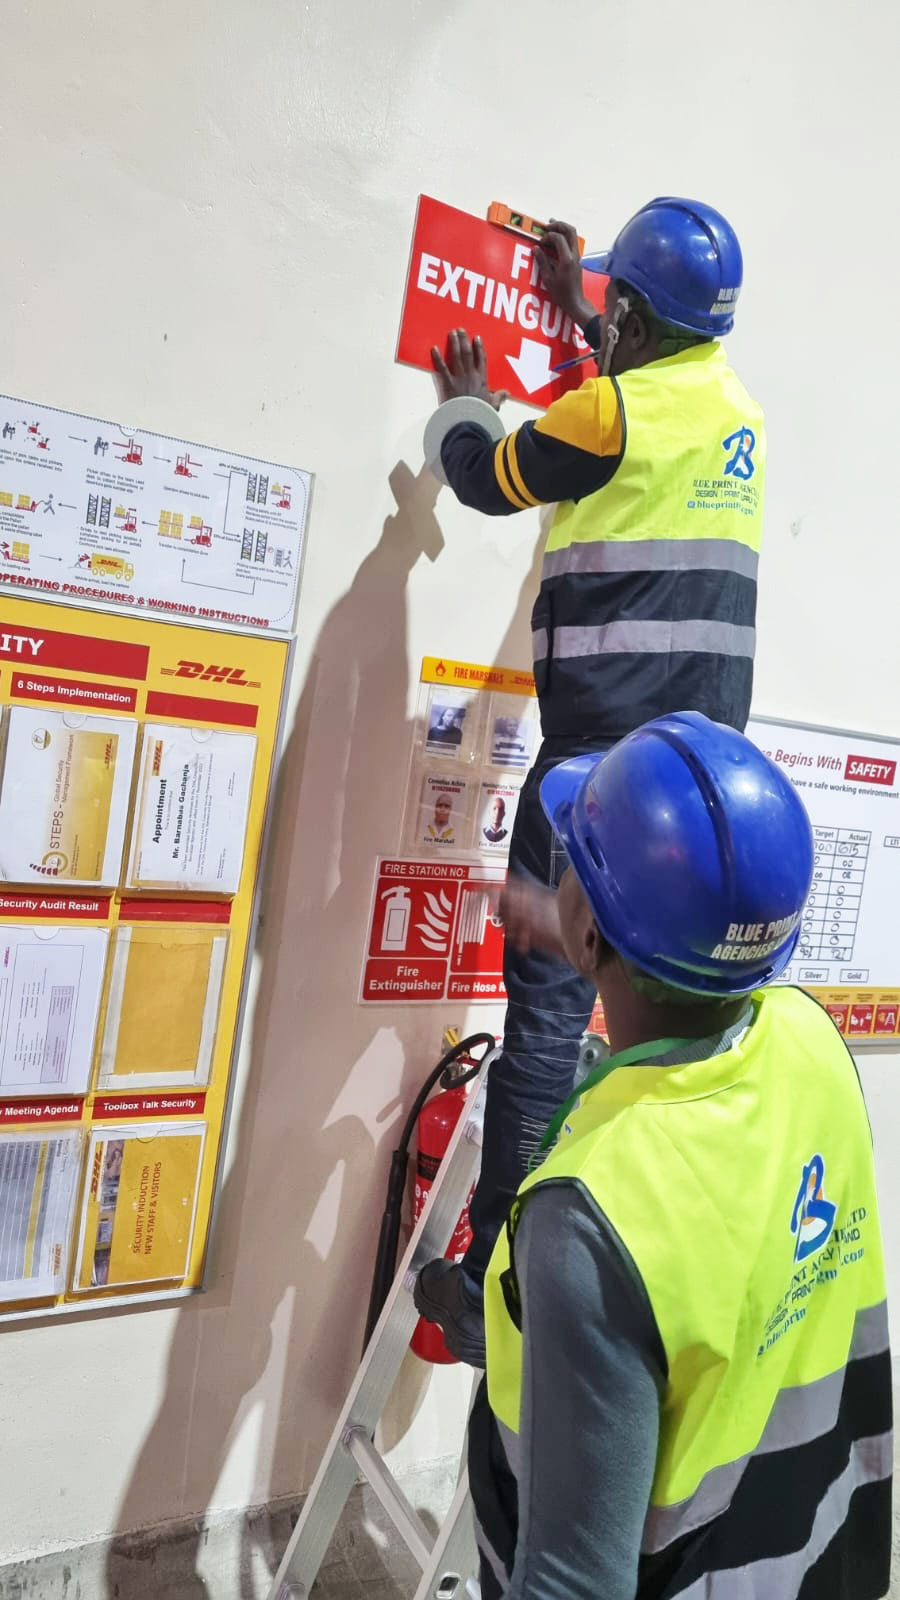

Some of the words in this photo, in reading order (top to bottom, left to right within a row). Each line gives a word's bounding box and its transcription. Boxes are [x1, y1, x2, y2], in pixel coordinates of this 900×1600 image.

[511, 243, 548, 290] FI
[417, 252, 597, 353] EXTINGUIS
[0, 573, 59, 591] PERATING
[63, 583, 135, 603] PROCEDURES
[138, 596, 145, 606] &
[148, 599, 196, 614] WORKING
[198, 607, 270, 627] INSTRUCTIONS
[168, 660, 256, 687] DHL
[454, 667, 469, 680] FIRE
[17, 680, 24, 689] 6
[27, 682, 55, 694] Steps
[57, 685, 131, 703] Implementation
[774, 749, 814, 770] Begins
[816, 755, 843, 773] With
[848, 761, 893, 780] SAFETY
[178, 763, 189, 803] Gachanja
[814, 783, 828, 792] safe
[829, 785, 857, 797] working
[858, 788, 899, 802] environment
[152, 779, 168, 843] Appointment
[49, 811, 64, 849] STEPS
[174, 805, 184, 844] Barnabas
[815, 829, 834, 840] Target
[849, 833, 868, 843] Actual
[172, 847, 180, 859] Mr.
[385, 863, 406, 873] FIRE
[407, 865, 448, 876] STATION
[449, 866, 466, 877] NO:
[40, 900, 67, 910] Audit
[68, 901, 99, 912] Result
[725, 923, 765, 942] BLUE
[710, 941, 777, 961] AGENCIES
[396, 966, 419, 977] Fire
[805, 971, 823, 979] Silver
[847, 972, 862, 980] Gold
[369, 979, 443, 993] Extinguisher
[451, 982, 470, 992] Fire
[472, 982, 497, 993] Hose
[498, 982, 508, 992] R
[5, 1105, 42, 1117] Meeting
[43, 1104, 80, 1116] Agenda
[103, 1101, 140, 1111] Toolbox
[142, 1101, 159, 1110] Talk
[160, 1099, 197, 1110] Security
[91, 1150, 103, 1196] DHL
[151, 1162, 162, 1198] VISITORS
[138, 1166, 151, 1213] INDUCTION
[133, 1213, 144, 1254] SECURITY
[147, 1211, 157, 1238] STAFF
